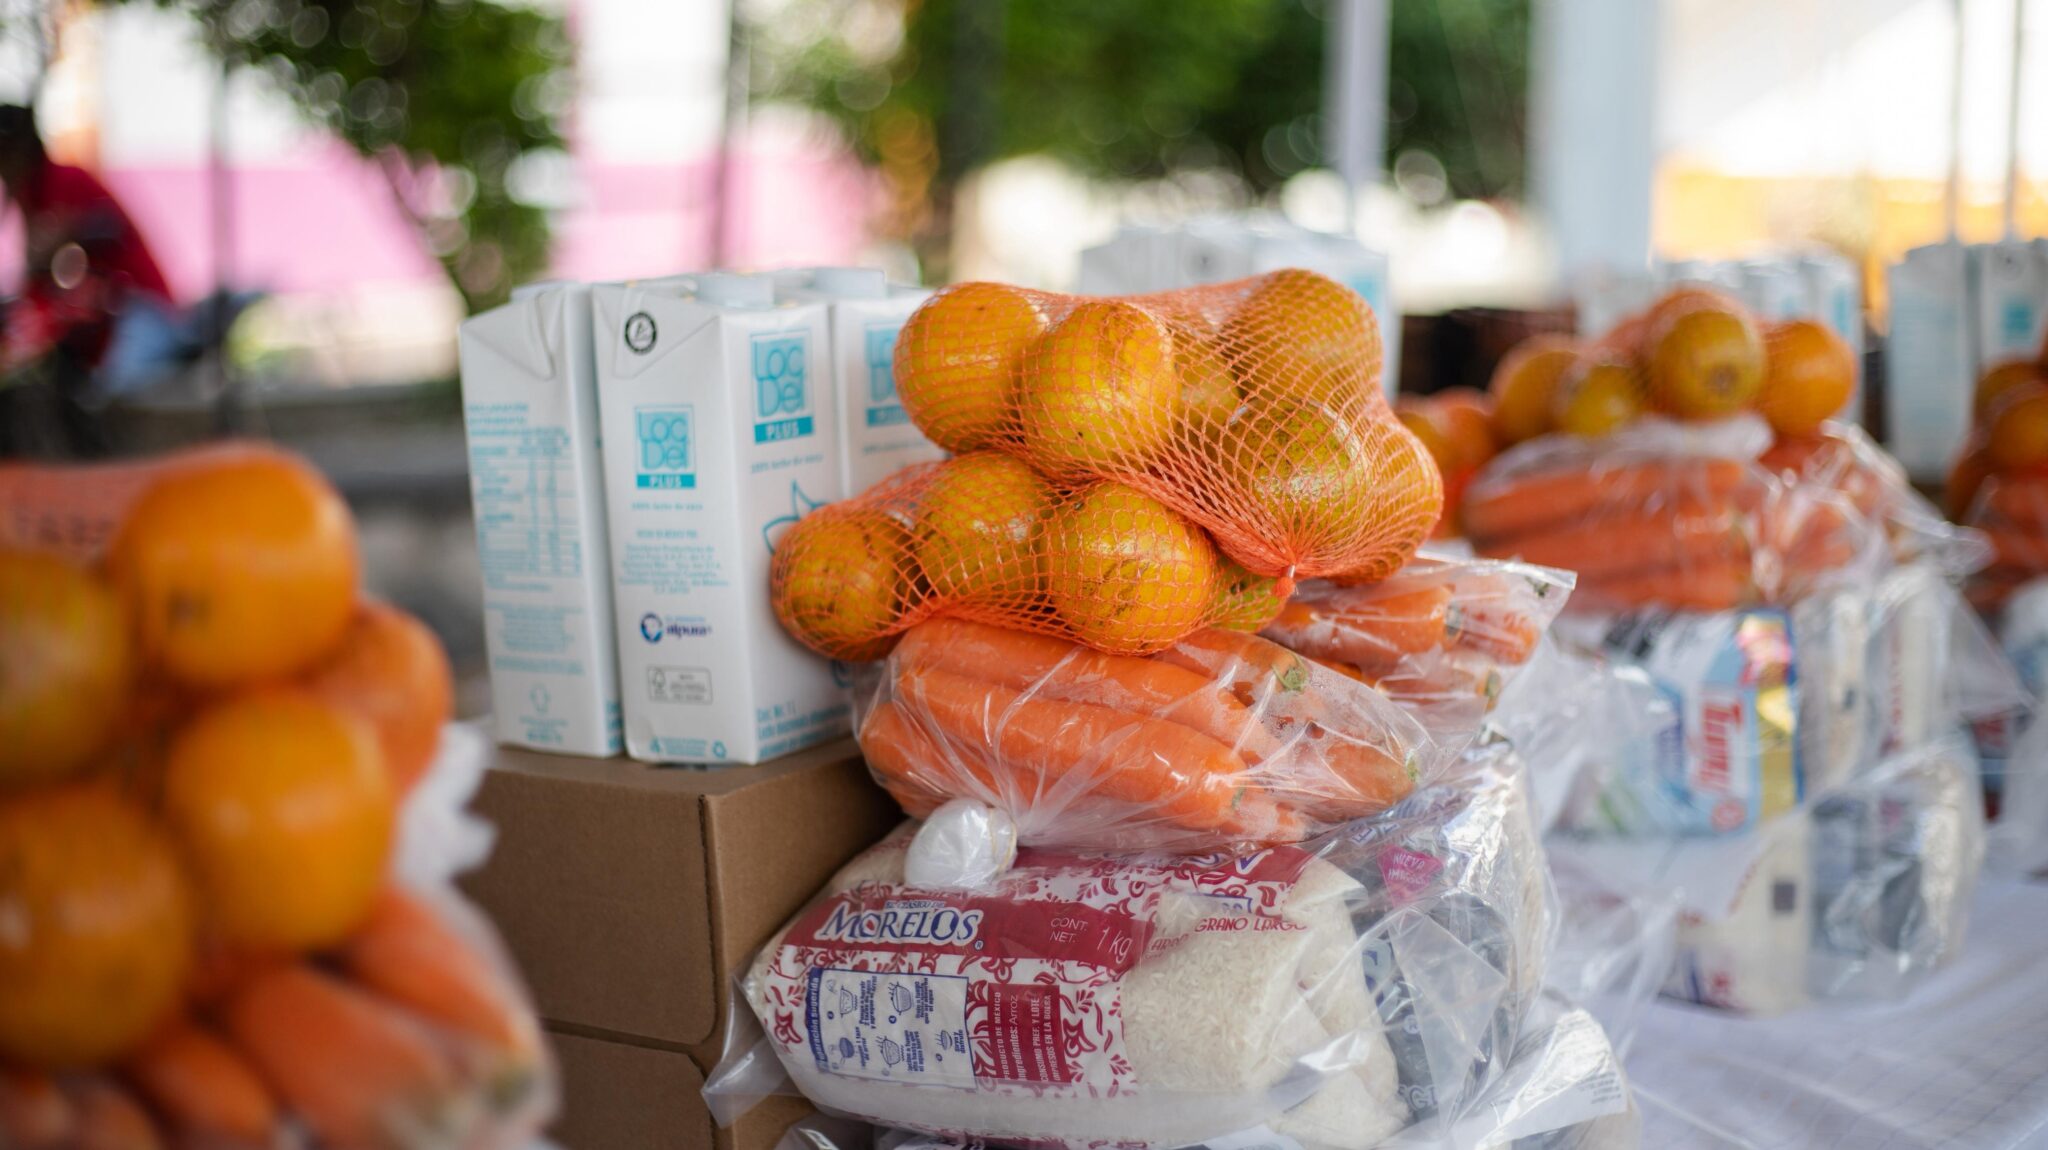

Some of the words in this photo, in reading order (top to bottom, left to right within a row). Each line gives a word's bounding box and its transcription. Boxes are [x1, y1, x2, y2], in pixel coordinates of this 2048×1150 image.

[753, 339, 804, 380] Loc
[638, 412, 687, 443] Loc
[766, 421, 799, 442] PLUS
[649, 474, 681, 488] PLUS
[1393, 853, 1424, 870] NUEVA
[818, 903, 981, 942] MORELOS
[1050, 917, 1087, 931] CONT.
[1194, 916, 1249, 933] GRANO
[1050, 931, 1076, 943] NET.
[1098, 925, 1108, 950] 1
[1110, 932, 1133, 964] kg
[1151, 933, 1189, 950] ARR
[810, 977, 820, 1018] sugerida
[1031, 998, 1040, 1017] LOTE
[1009, 995, 1018, 1025] Arroz
[996, 1027, 1002, 1036] DE
[1032, 1026, 1040, 1046] PREF.
[1044, 1022, 1052, 1032] LA
[1044, 1034, 1052, 1044] EN
[997, 1039, 1011, 1080] PRODUCTO
[1034, 1048, 1048, 1081] CONSUMO
[1046, 1046, 1061, 1081] IMPRESOS
